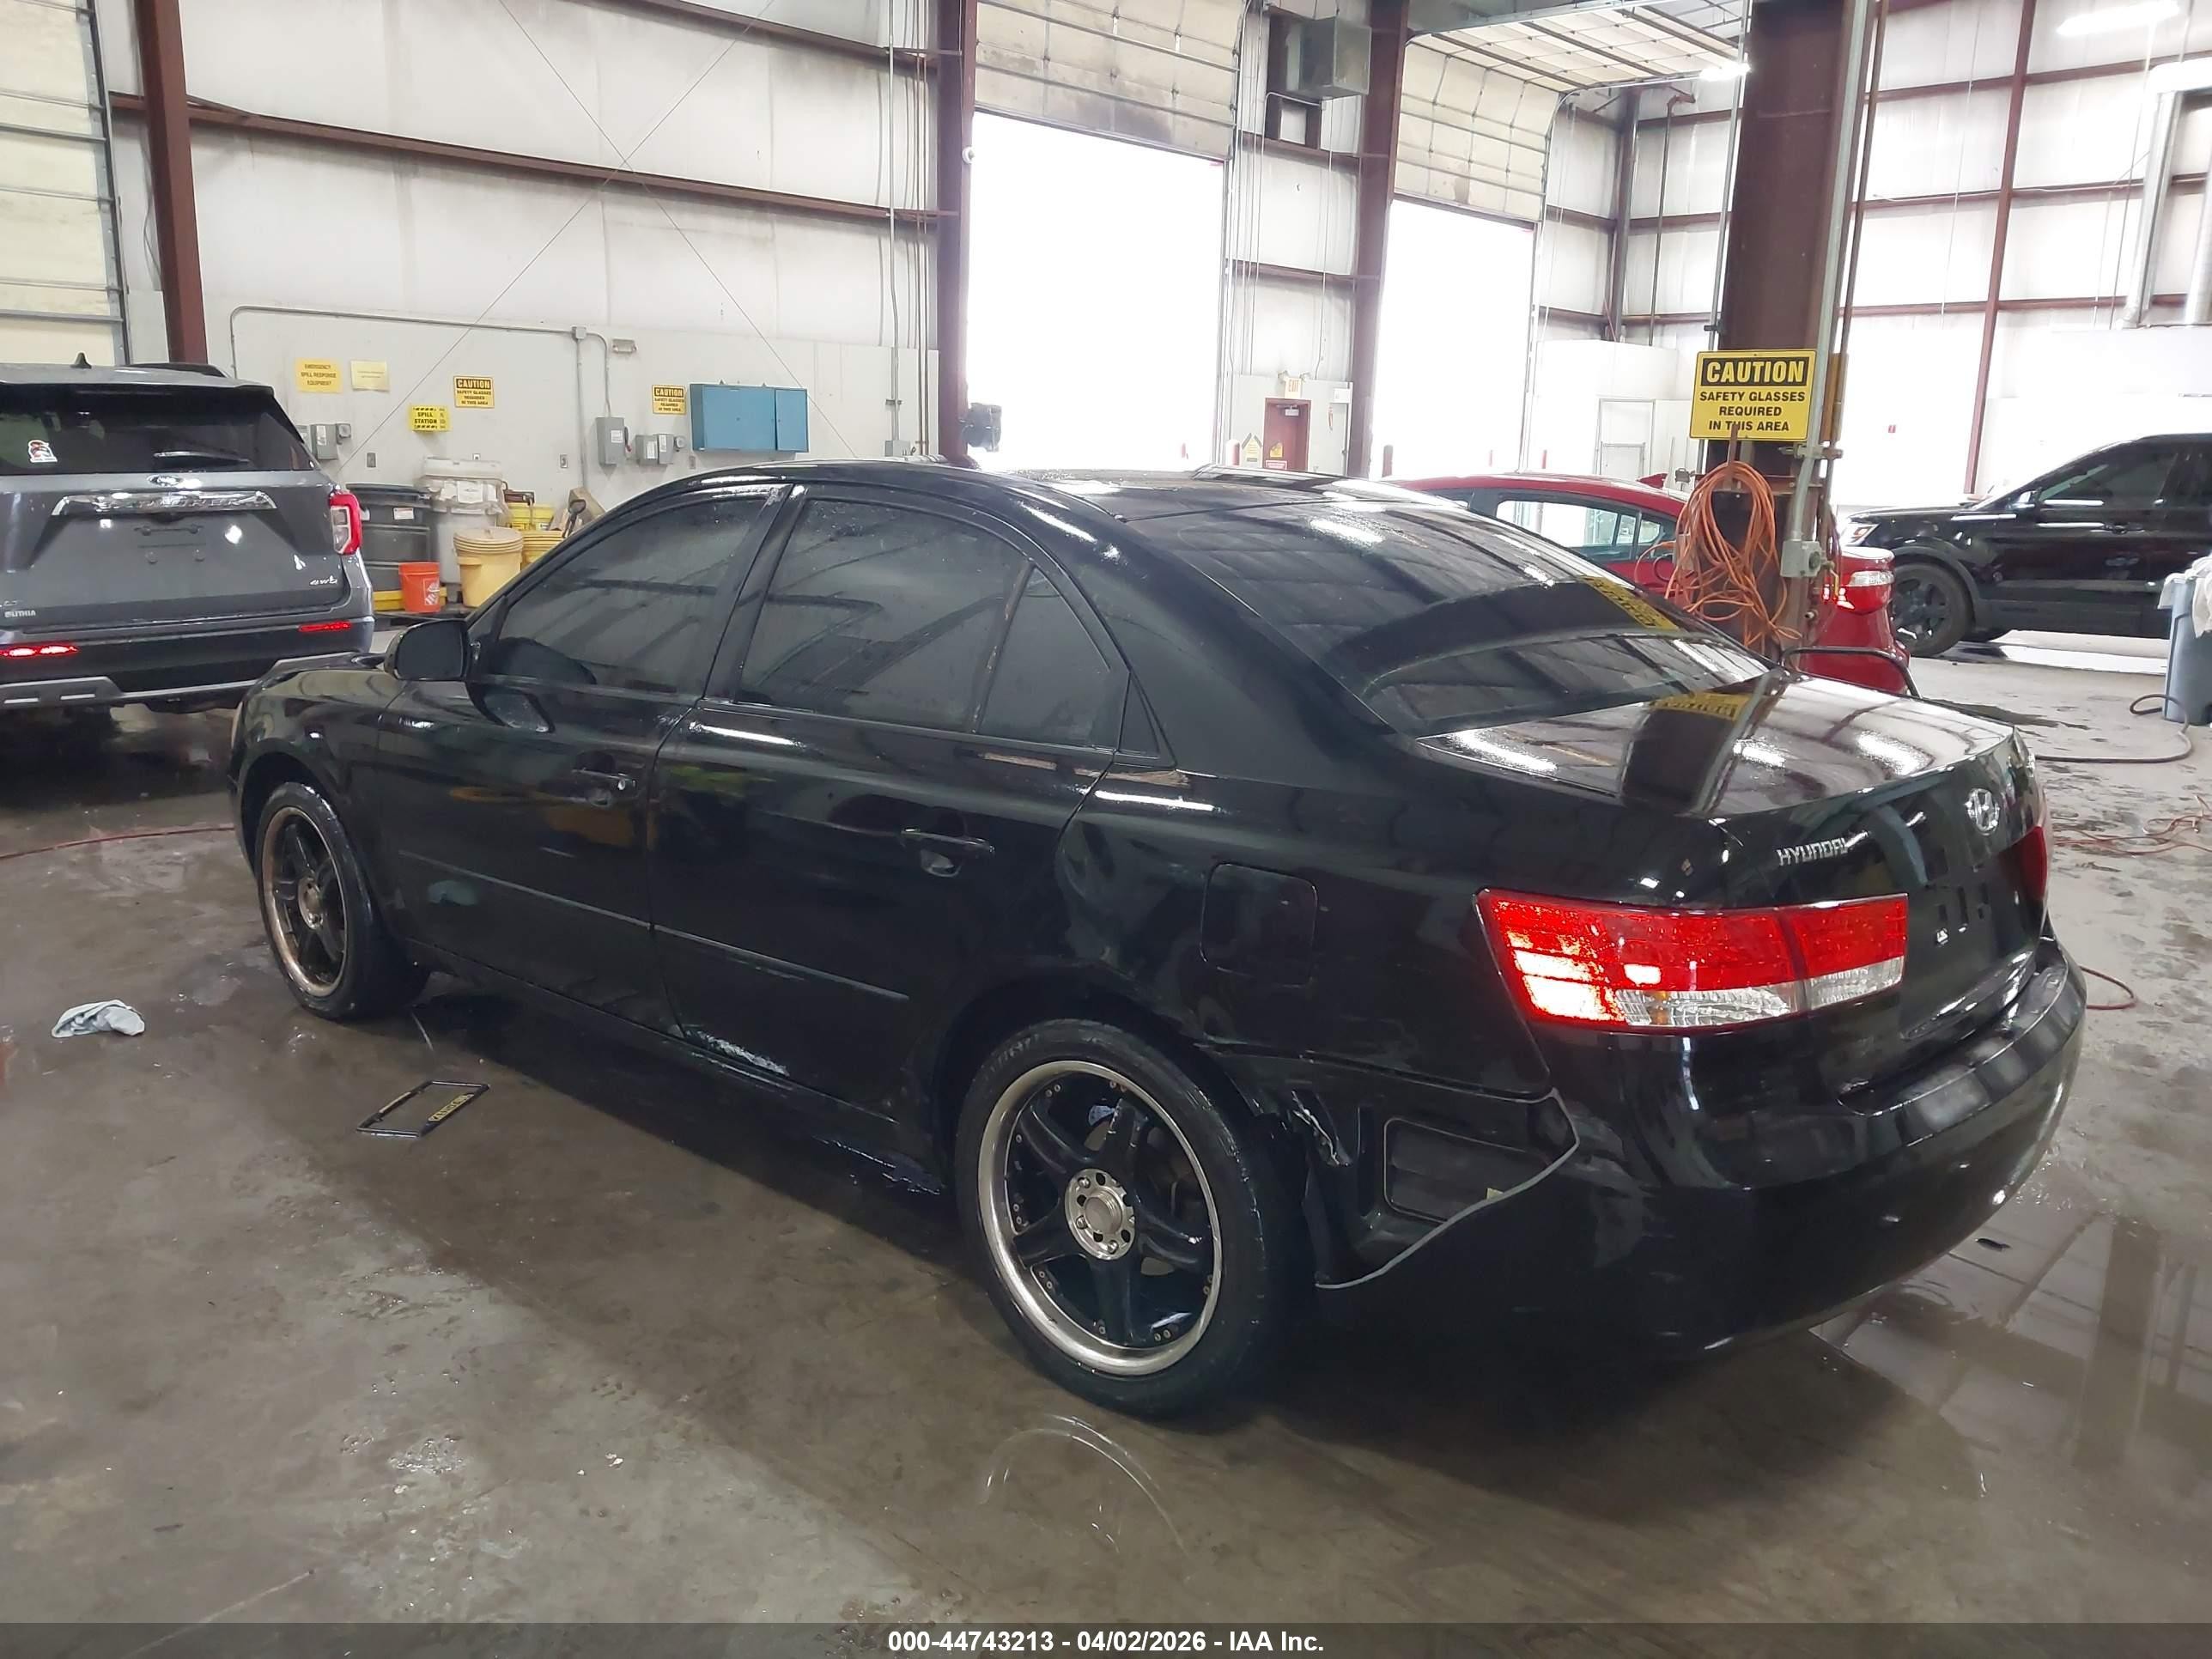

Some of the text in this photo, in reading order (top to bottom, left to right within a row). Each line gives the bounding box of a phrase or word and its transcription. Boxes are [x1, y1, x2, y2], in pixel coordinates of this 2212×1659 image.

[1706, 361, 1804, 383] CAUTION
[458, 380, 489, 388] CAUTION
[1288, 380, 1299, 392] EXIT
[655, 388, 683, 397] CAUTION
[1699, 392, 1805, 401] SAFETY GLASSES
[1718, 406, 1782, 416] REQUIRED
[1709, 420, 1722, 430] IN
[1756, 421, 1790, 431] AREA
[1776, 837, 1849, 866] HYUNDAI
